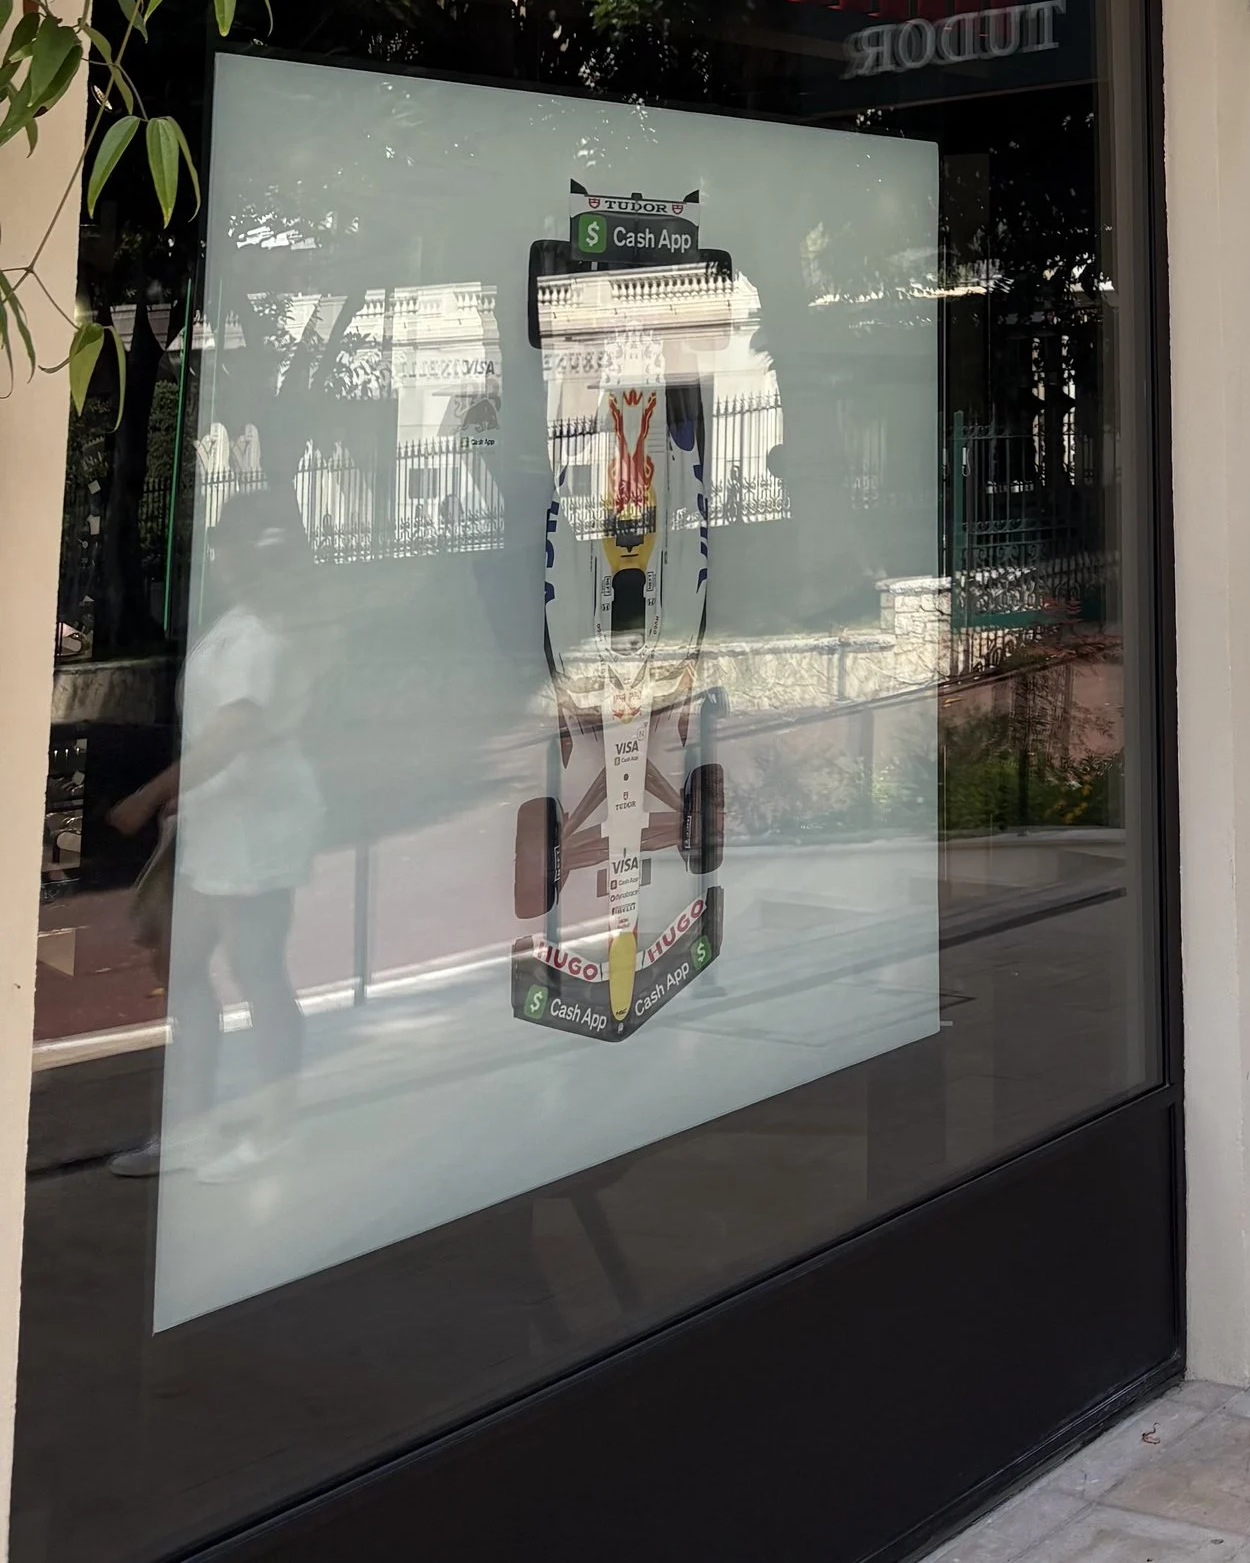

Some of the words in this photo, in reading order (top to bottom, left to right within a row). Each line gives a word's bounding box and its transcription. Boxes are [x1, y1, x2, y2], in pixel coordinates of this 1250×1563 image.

[605, 199, 668, 214] TUDOR
[613, 226, 655, 249] Cash
[658, 229, 692, 254] App
[463, 359, 496, 376] VISA
[615, 740, 639, 755] VISA
[612, 856, 639, 875] VISA
[647, 898, 705, 964] HUGO
[534, 941, 599, 981] HUGO
[634, 982, 664, 1016] Cash
[666, 961, 690, 991] App
[550, 998, 581, 1022] Cash
[582, 1006, 607, 1032] App
